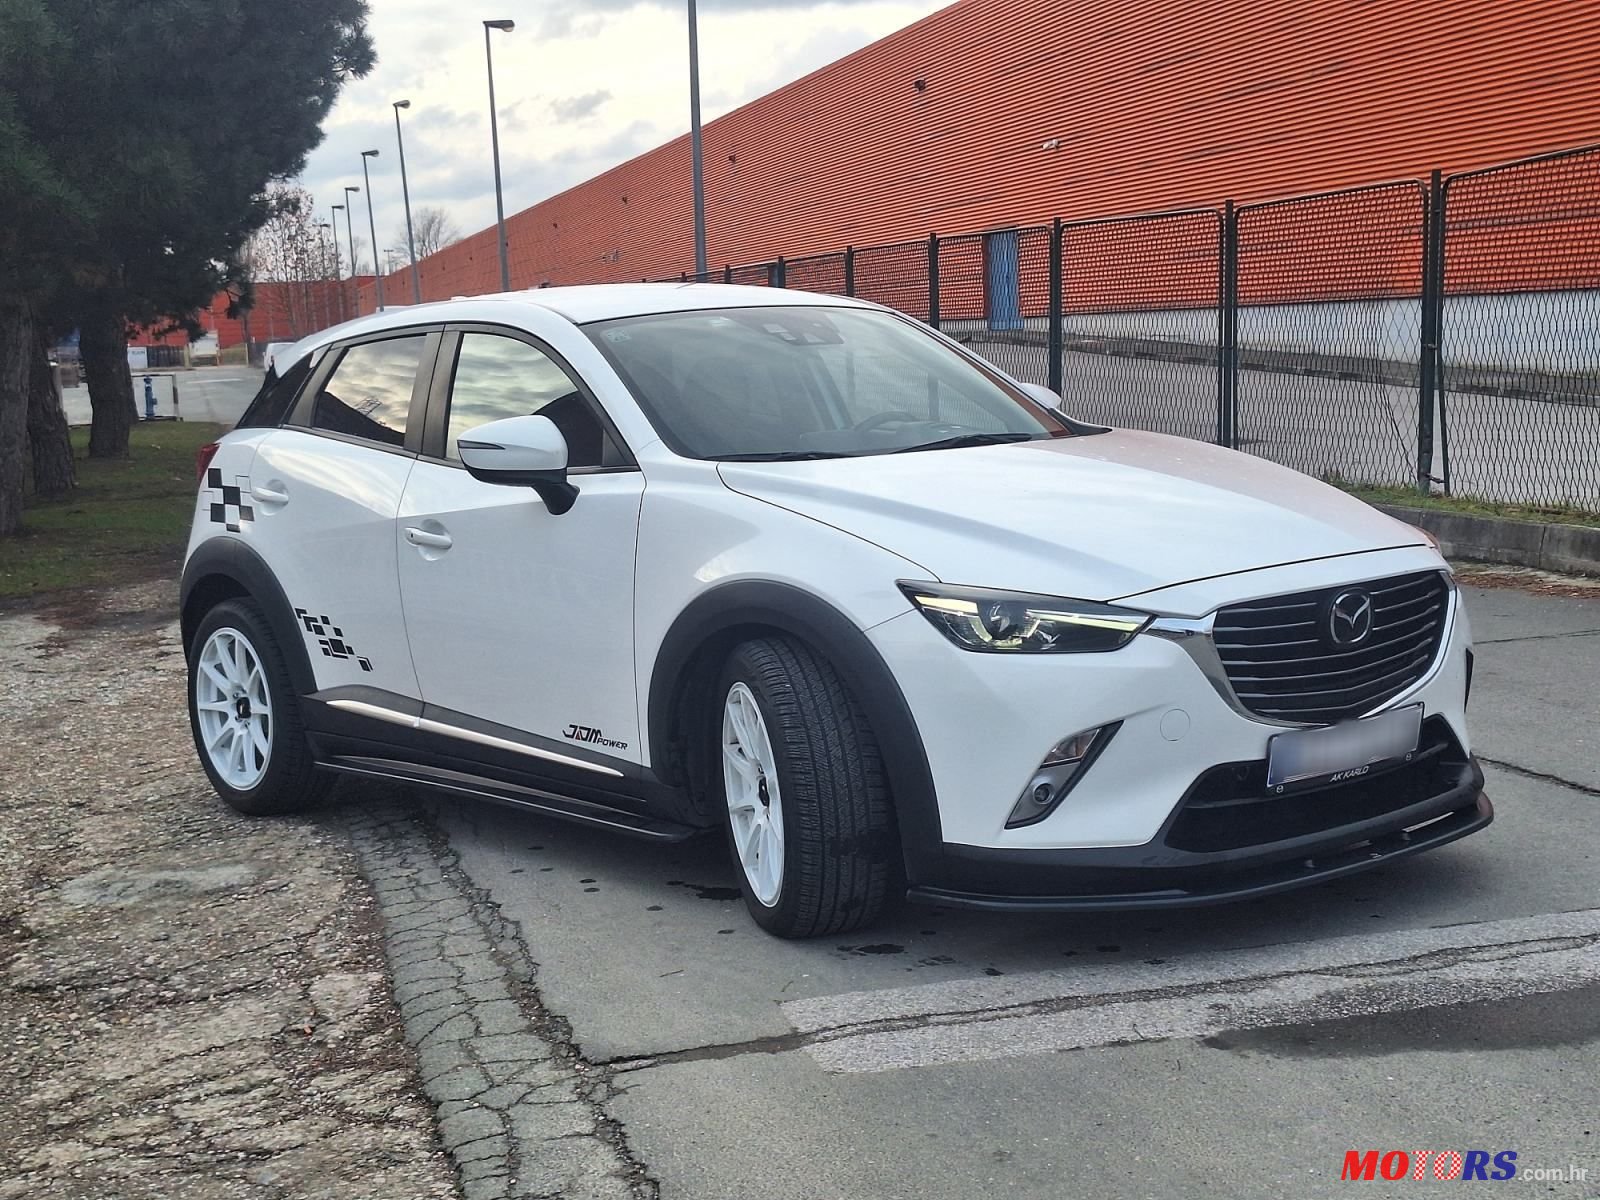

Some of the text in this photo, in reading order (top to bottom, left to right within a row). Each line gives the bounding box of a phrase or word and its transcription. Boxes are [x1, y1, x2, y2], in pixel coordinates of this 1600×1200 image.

[562, 724, 628, 750] JDM POWER
[1343, 765, 1369, 779] KARLO
